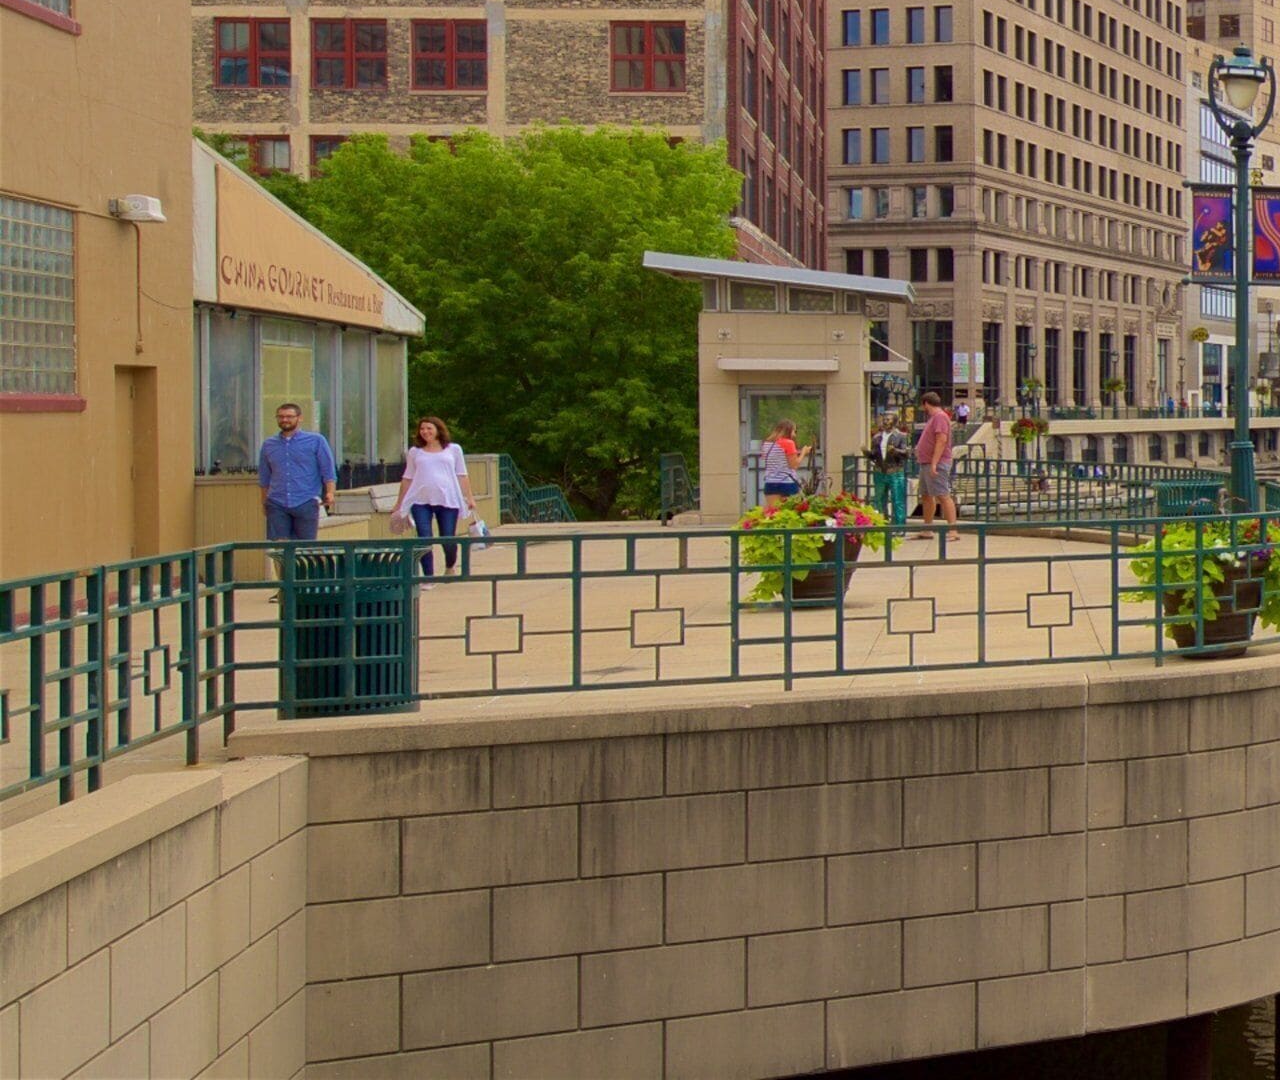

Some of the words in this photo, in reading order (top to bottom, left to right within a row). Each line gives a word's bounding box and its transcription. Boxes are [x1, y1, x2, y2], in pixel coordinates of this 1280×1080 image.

[221, 255, 266, 292] CHINA
[268, 264, 325, 303] GOURMET
[327, 283, 366, 313] Restaurant
[373, 293, 384, 315] Bar
